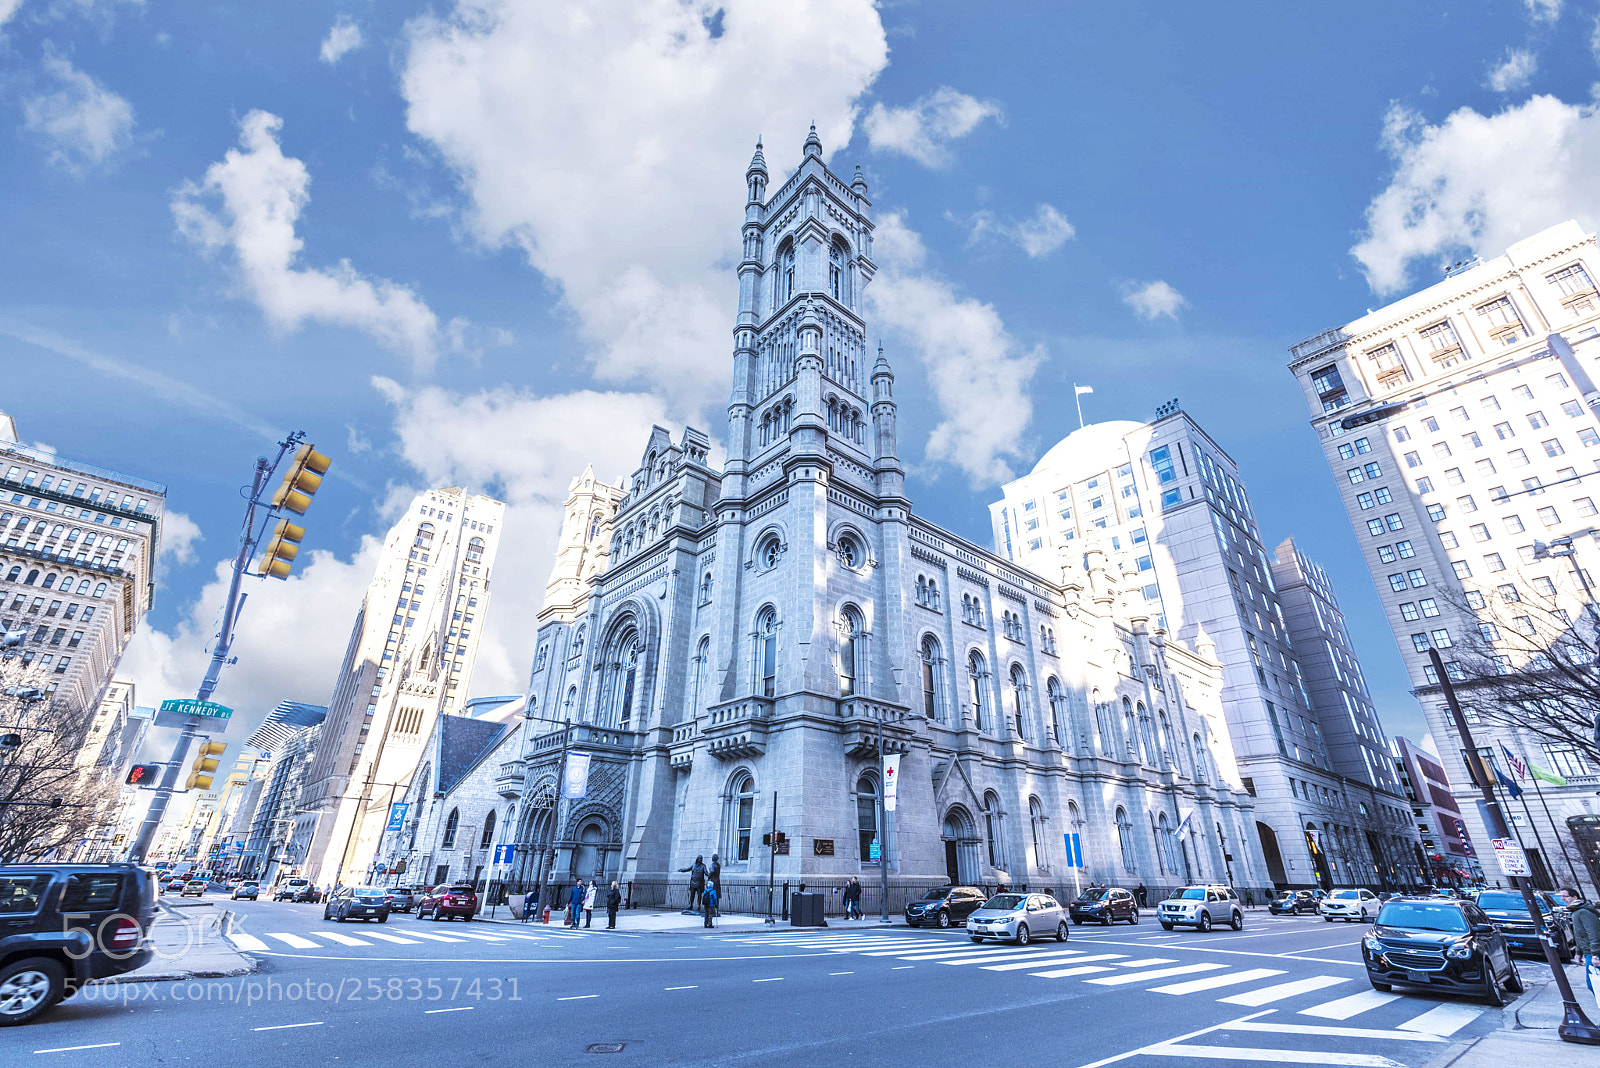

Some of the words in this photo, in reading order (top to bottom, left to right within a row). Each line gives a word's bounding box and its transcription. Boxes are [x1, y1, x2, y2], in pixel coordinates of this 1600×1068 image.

[162, 702, 175, 711] JF
[177, 703, 219, 717] KENNEDY
[1457, 827, 1469, 849] PARK
[1493, 841, 1505, 849] NO
